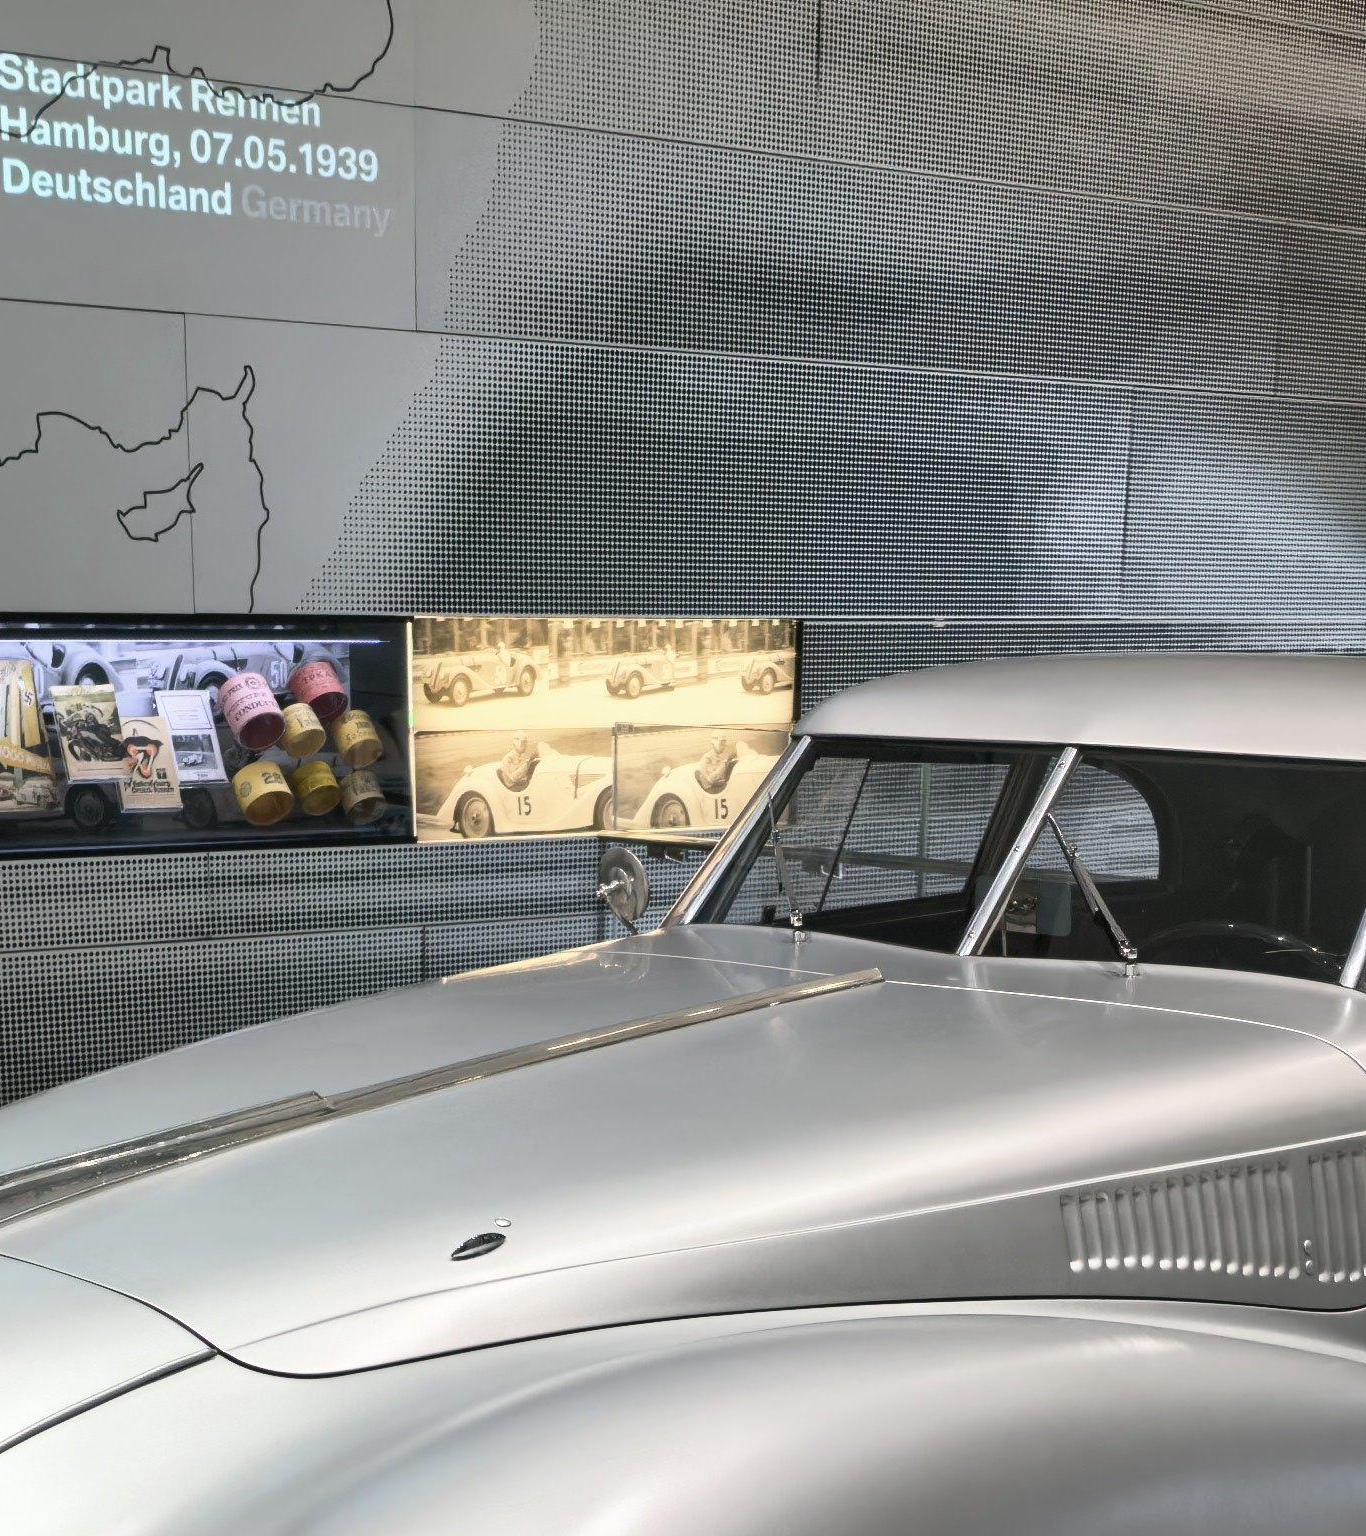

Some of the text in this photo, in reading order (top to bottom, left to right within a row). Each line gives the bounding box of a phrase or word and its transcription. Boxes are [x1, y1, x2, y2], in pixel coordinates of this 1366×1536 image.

[191, 77, 321, 128] Rennen
[190, 128, 379, 183] 07.05.1939
[1, 157, 395, 238] Deutschland Germany
[517, 795, 532, 816] 15
[714, 798, 728, 820] 15
